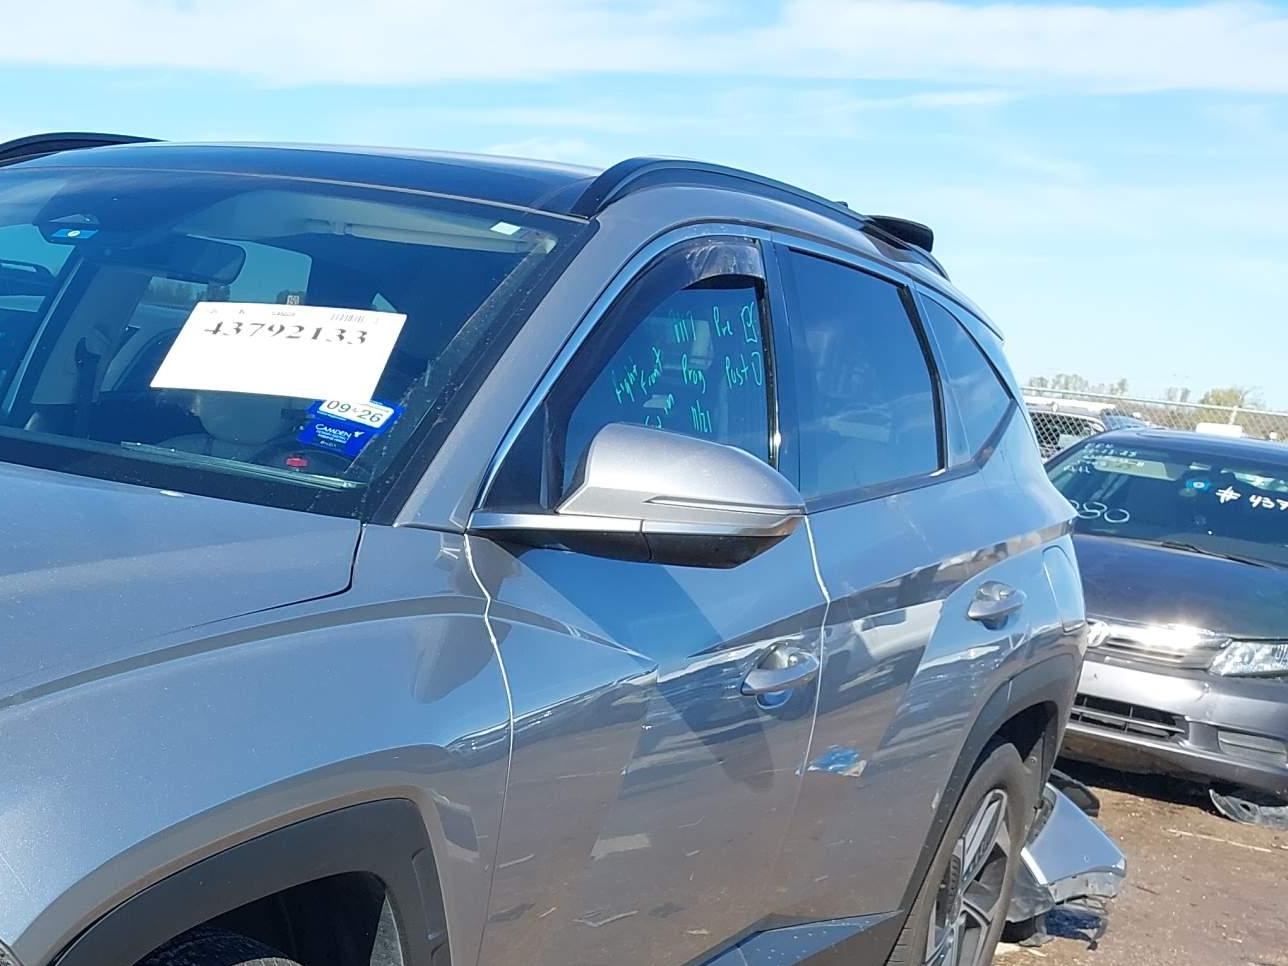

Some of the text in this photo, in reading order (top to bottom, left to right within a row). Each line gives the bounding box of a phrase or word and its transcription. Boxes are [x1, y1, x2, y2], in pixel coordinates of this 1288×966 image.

[204, 321, 368, 345] 43792133
[326, 400, 352, 413] 09
[357, 409, 384, 423] 26
[315, 423, 352, 440] CAMDEN
